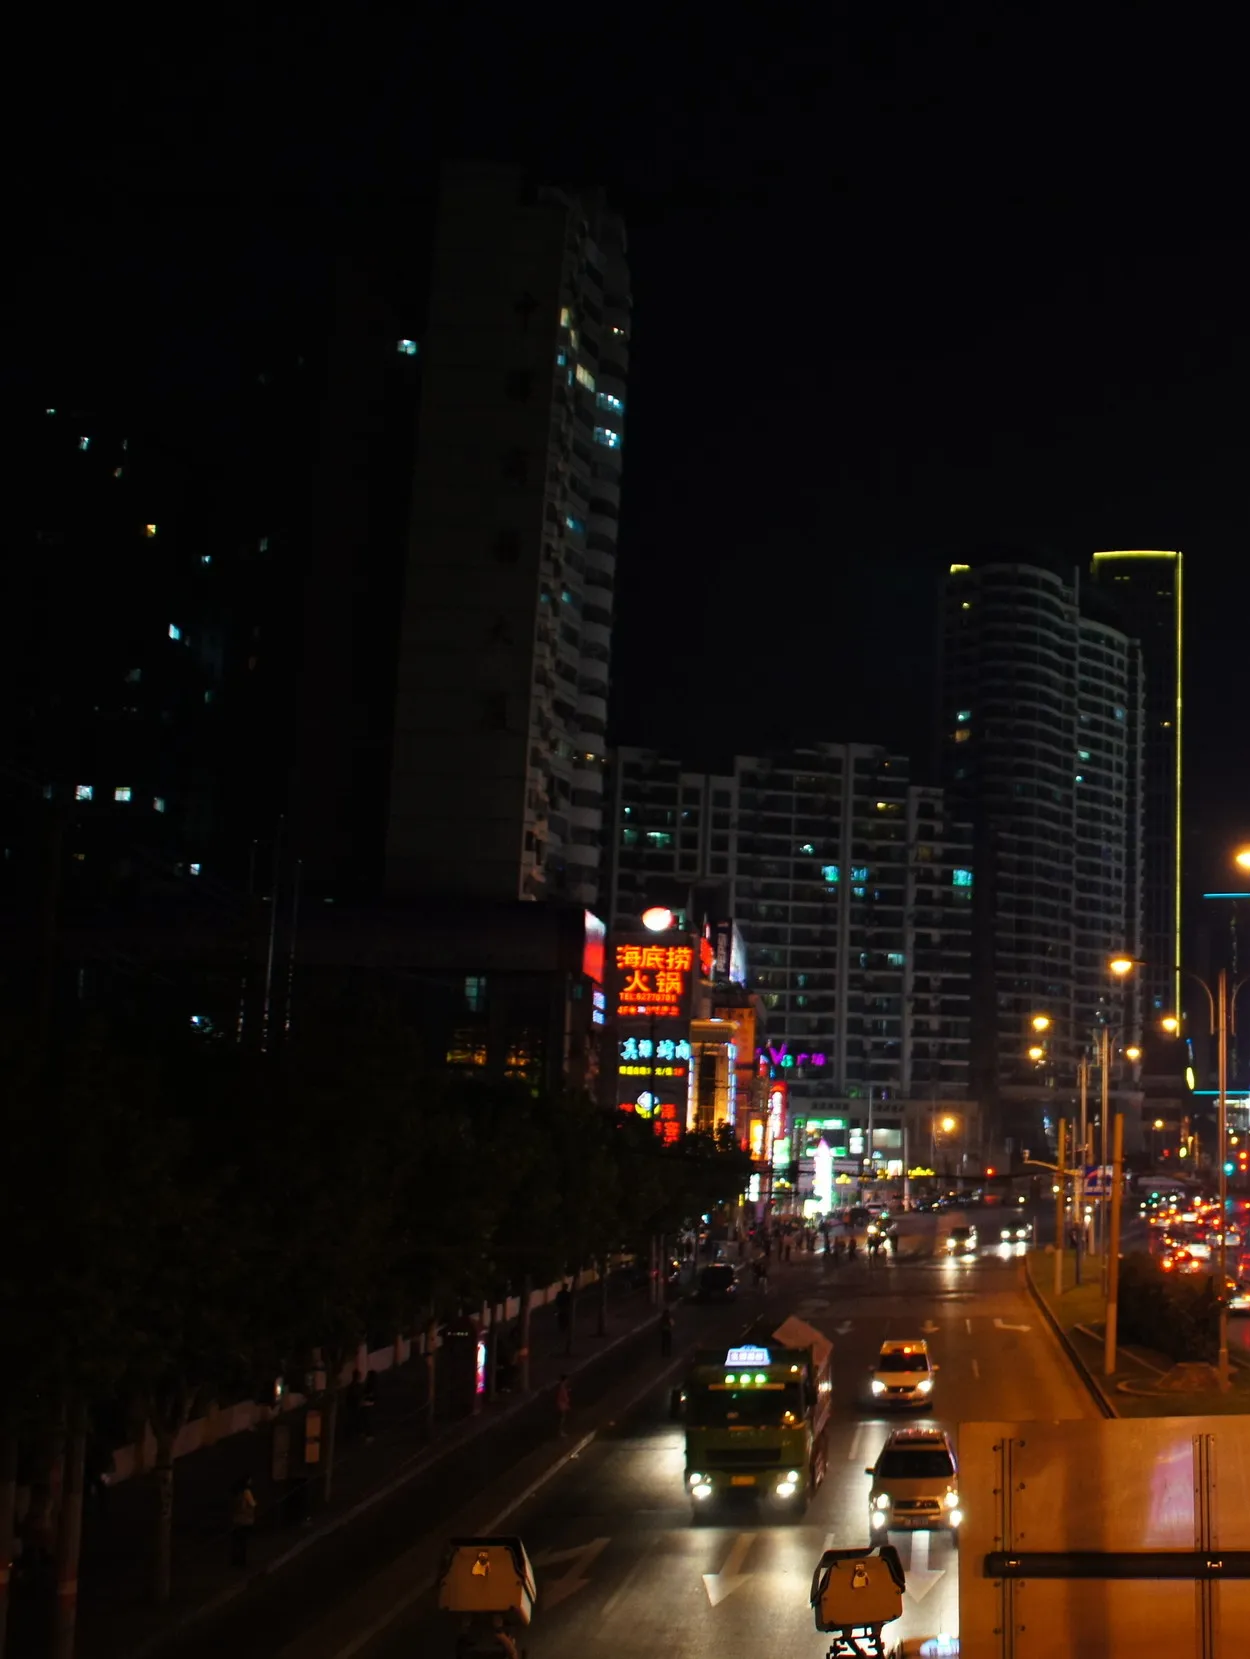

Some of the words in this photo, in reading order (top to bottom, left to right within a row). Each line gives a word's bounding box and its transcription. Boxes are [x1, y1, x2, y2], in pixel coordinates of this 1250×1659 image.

[616, 944, 694, 971] 海底捞
[623, 970, 684, 994] 火锅
